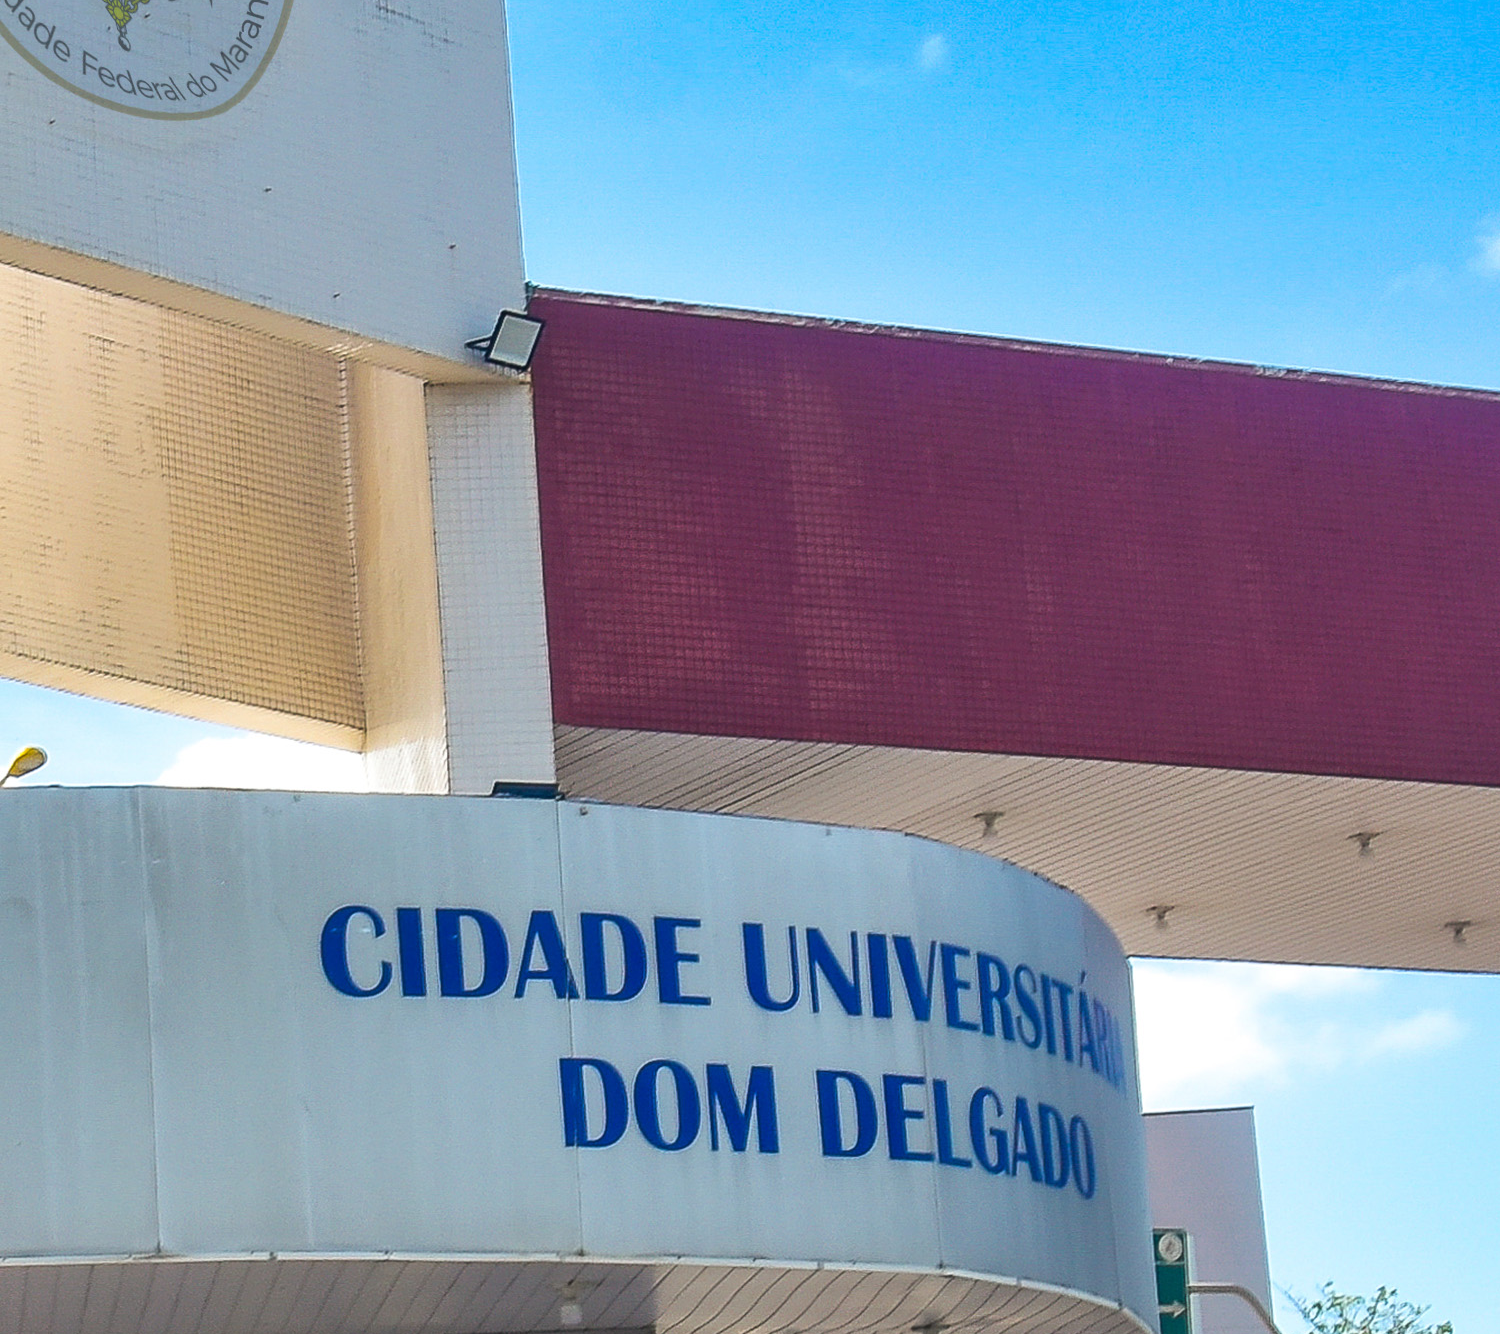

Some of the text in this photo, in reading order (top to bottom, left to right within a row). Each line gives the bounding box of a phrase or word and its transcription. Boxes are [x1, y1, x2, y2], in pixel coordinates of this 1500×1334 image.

[81, 50, 186, 101] Federal
[186, 73, 218, 98] do
[319, 904, 712, 1007] CIDADE
[559, 1056, 1096, 1200] DOM DELGADO
